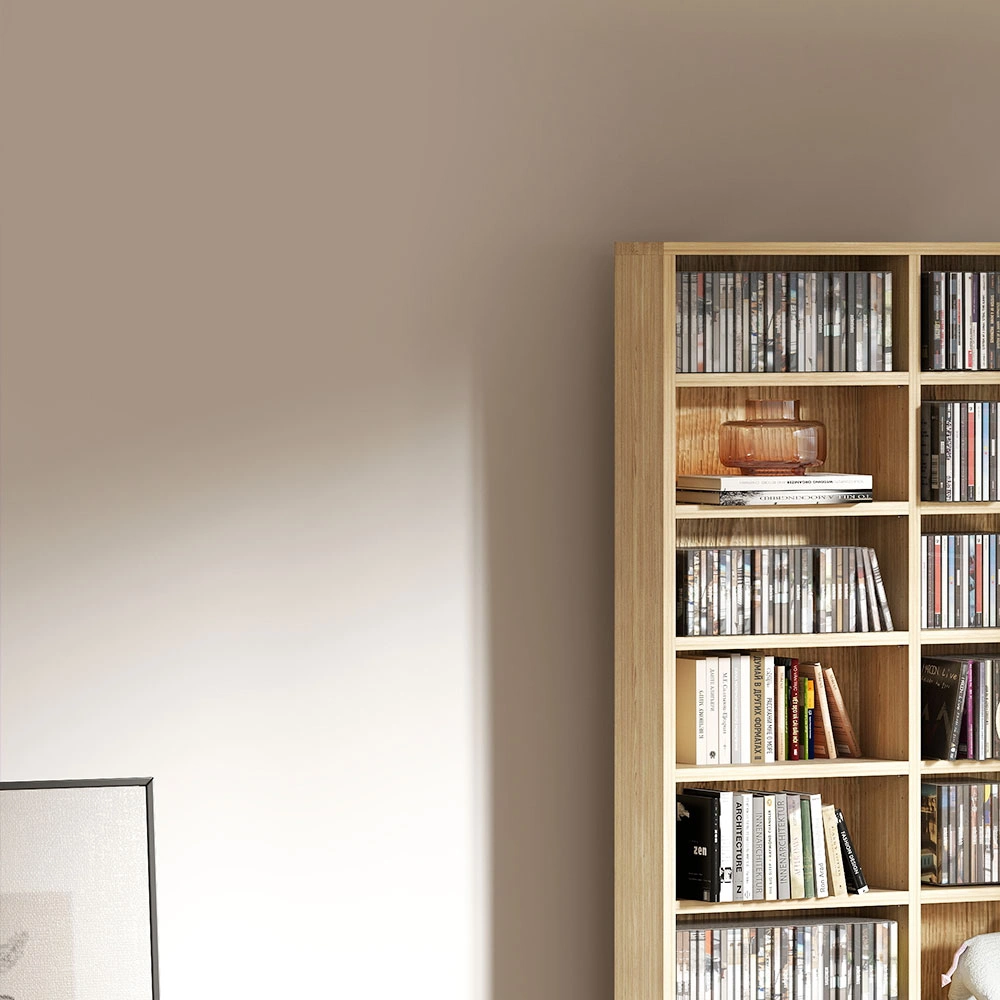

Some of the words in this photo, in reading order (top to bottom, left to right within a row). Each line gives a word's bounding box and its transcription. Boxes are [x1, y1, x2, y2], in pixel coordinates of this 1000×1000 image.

[753, 656, 762, 680] ДУМАЙ
[754, 689, 762, 715] ДРУГИХ
[694, 846, 707, 856] zen
[777, 800, 787, 884] INNENARCHITEKTUR
[841, 831, 852, 855] FASHION
